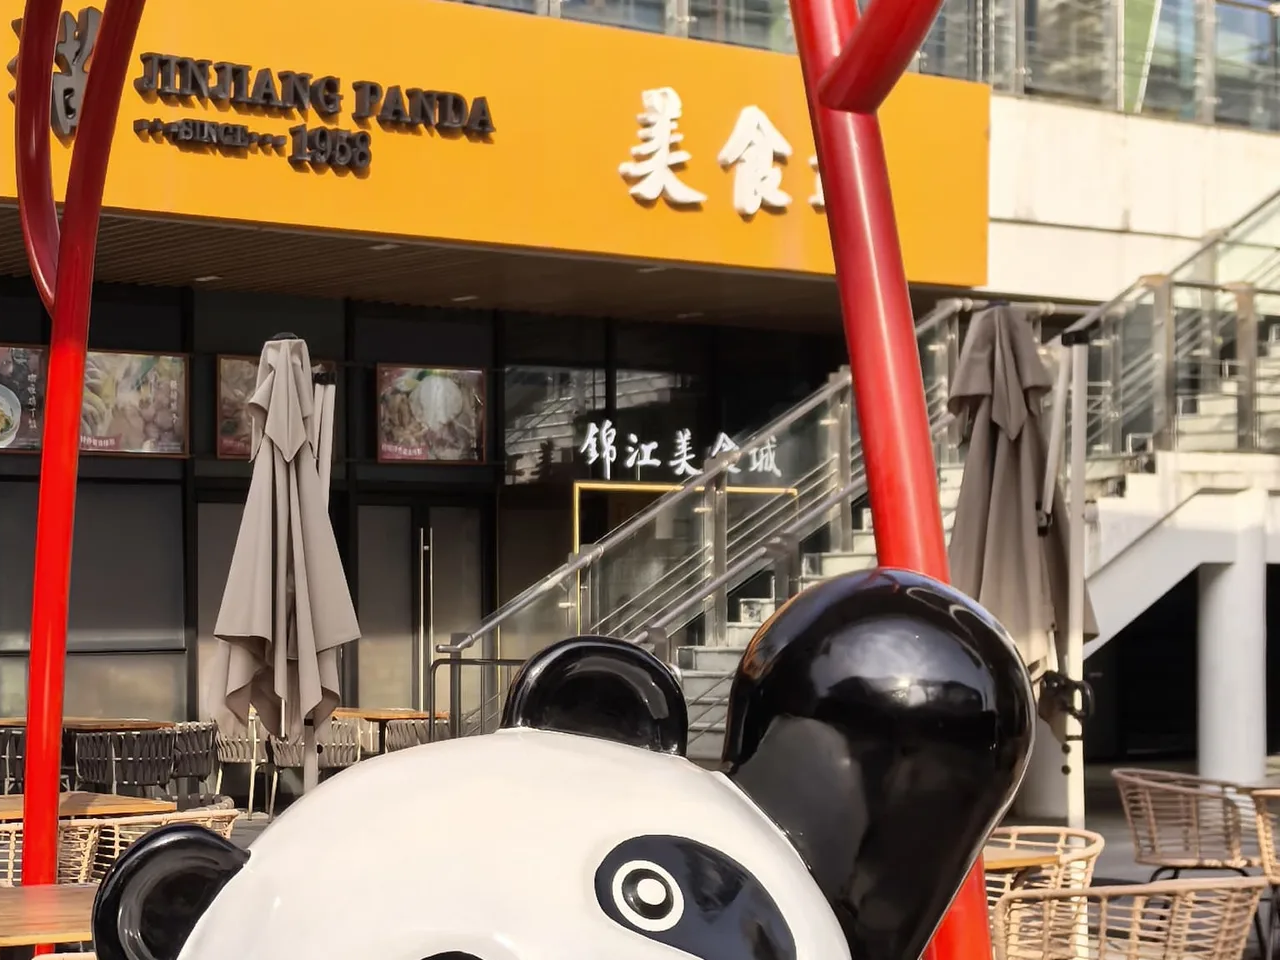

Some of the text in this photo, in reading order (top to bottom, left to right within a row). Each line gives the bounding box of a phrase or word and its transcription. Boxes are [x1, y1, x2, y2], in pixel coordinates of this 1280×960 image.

[134, 53, 494, 133] JINJIANG PANDA
[618, 86, 826, 215] 美食
